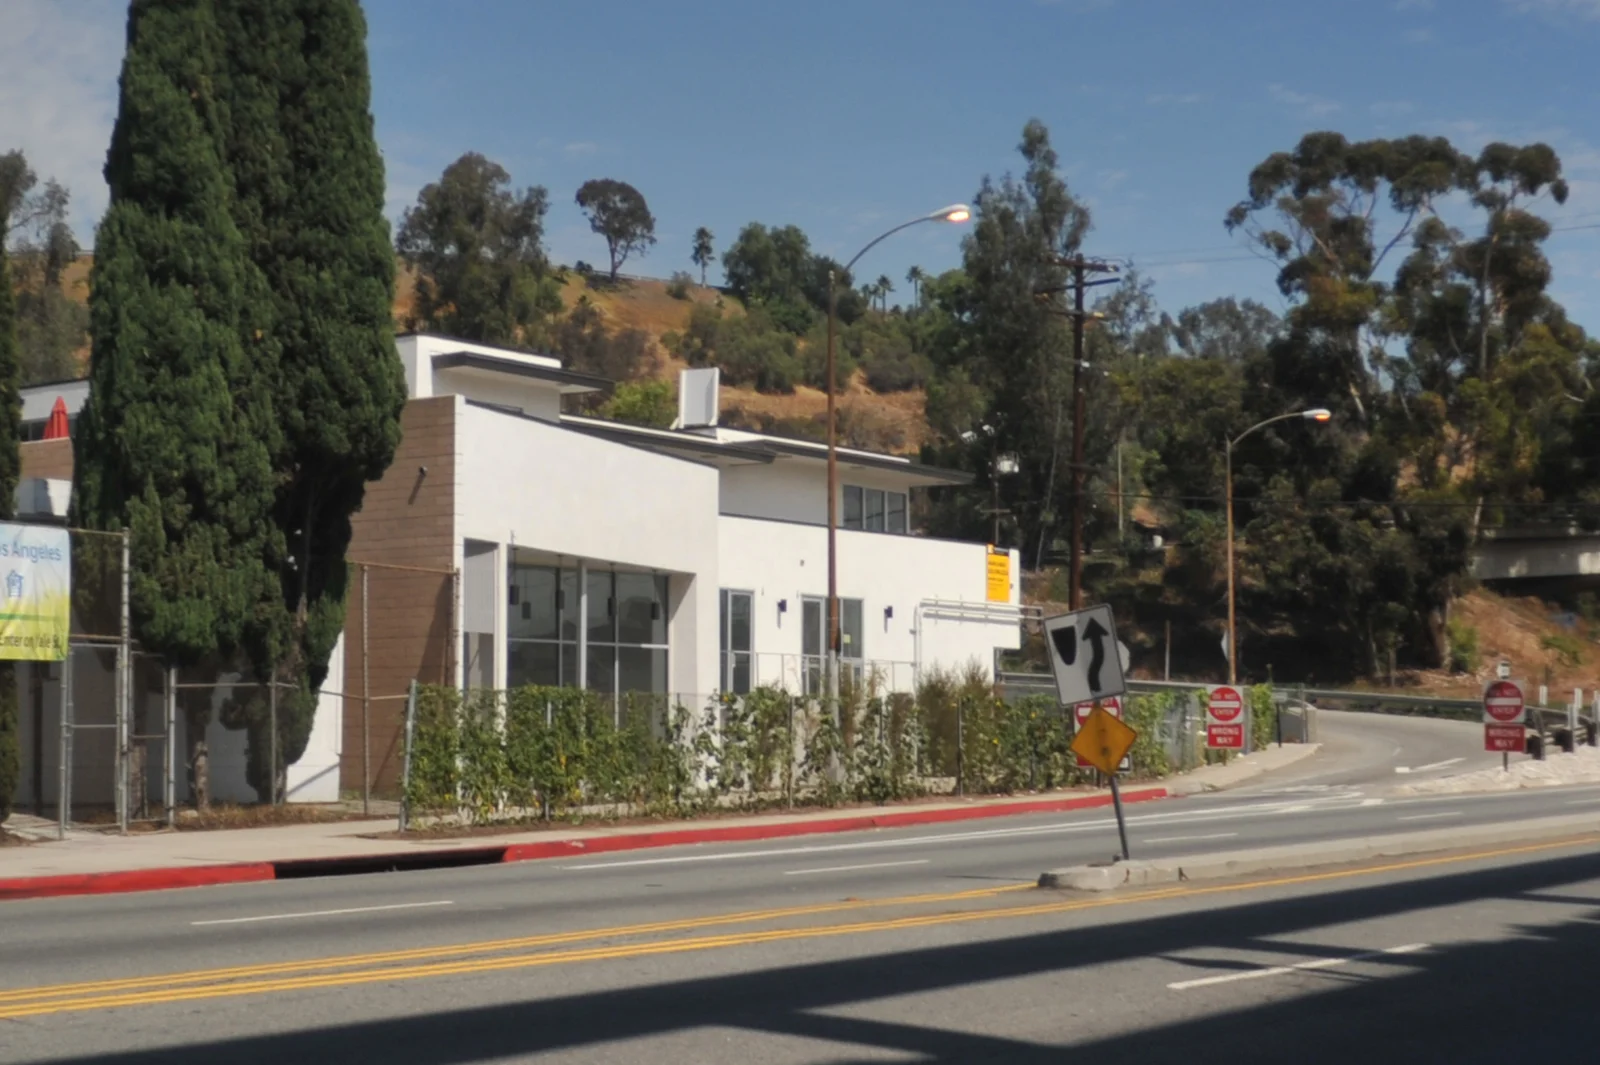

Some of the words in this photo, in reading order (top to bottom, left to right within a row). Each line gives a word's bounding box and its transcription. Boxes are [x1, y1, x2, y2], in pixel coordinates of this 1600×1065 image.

[12, 539, 61, 563] Angeles
[1503, 688, 1518, 697] NOT
[1214, 708, 1235, 716] ENTER
[1492, 707, 1515, 715] ENTER
[1211, 727, 1240, 736] WRONG
[1488, 728, 1520, 737] WRONG
[1216, 736, 1234, 744] WAY
[1494, 739, 1515, 748] WAY
